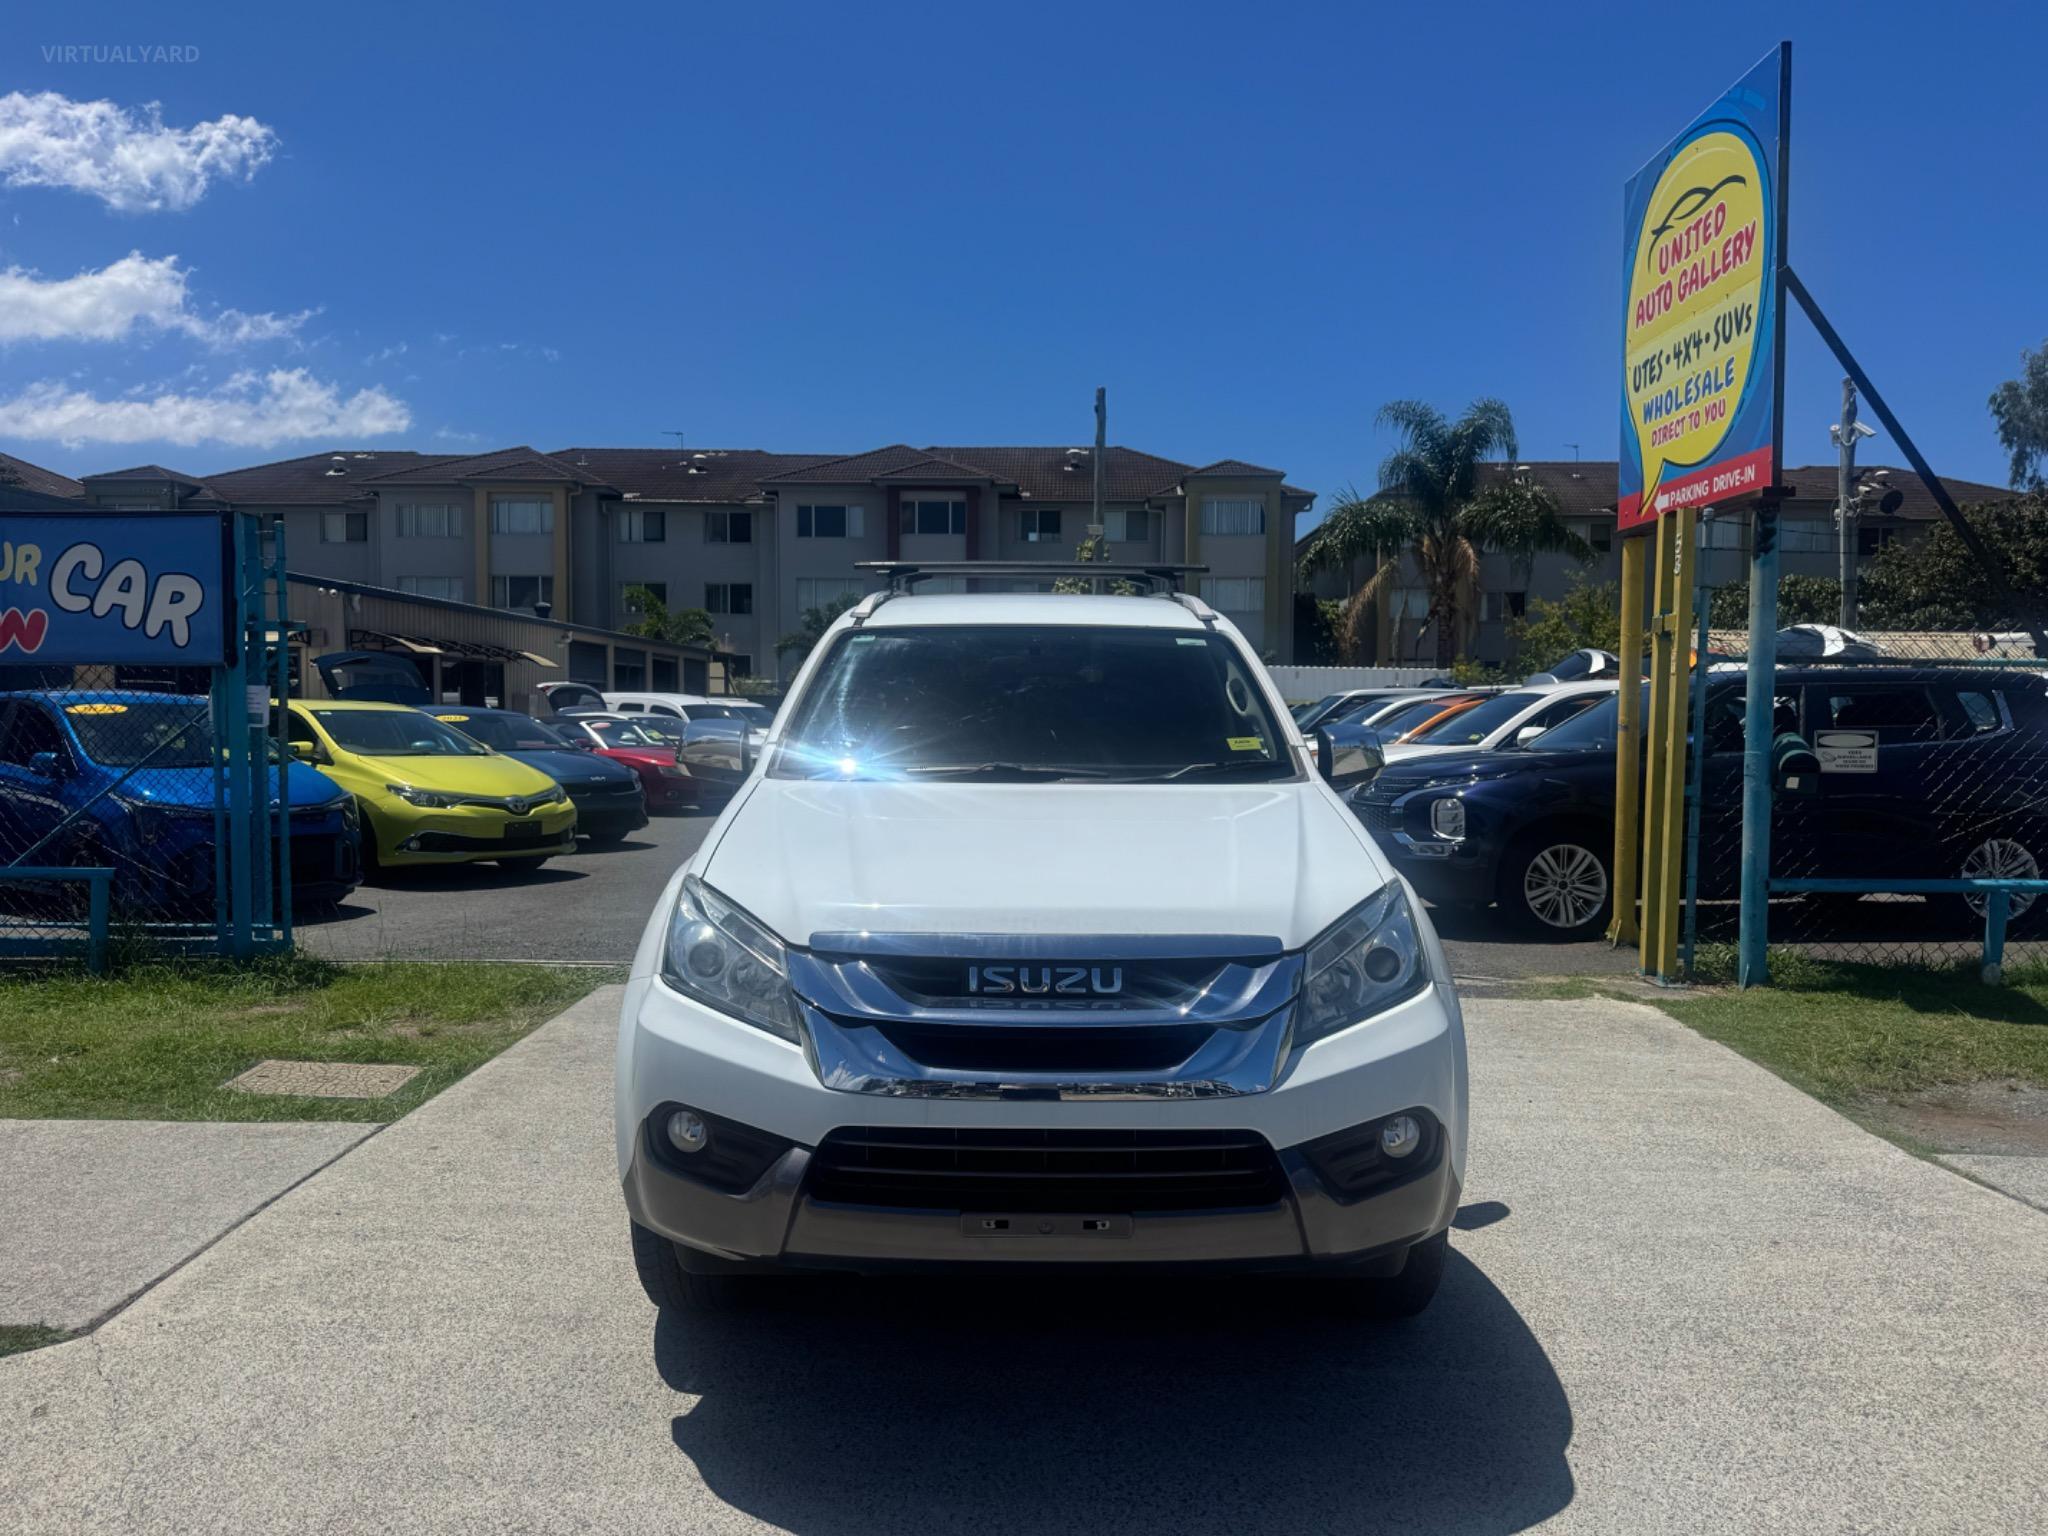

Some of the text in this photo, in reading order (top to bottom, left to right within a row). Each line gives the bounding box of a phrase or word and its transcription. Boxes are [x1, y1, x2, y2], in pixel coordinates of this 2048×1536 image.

[1658, 201, 1727, 276] UNITED
[1635, 220, 1756, 329] AUTO GALLERY
[1633, 349, 1663, 393] UTES
[1643, 356, 1735, 425] WHOLESALE
[1651, 398, 1726, 448] DIRECT TO YOU
[1670, 464, 1755, 506] PARKING DRIVE-IN
[50, 542, 204, 648] CAR
[969, 966, 1122, 993] ISUZU
